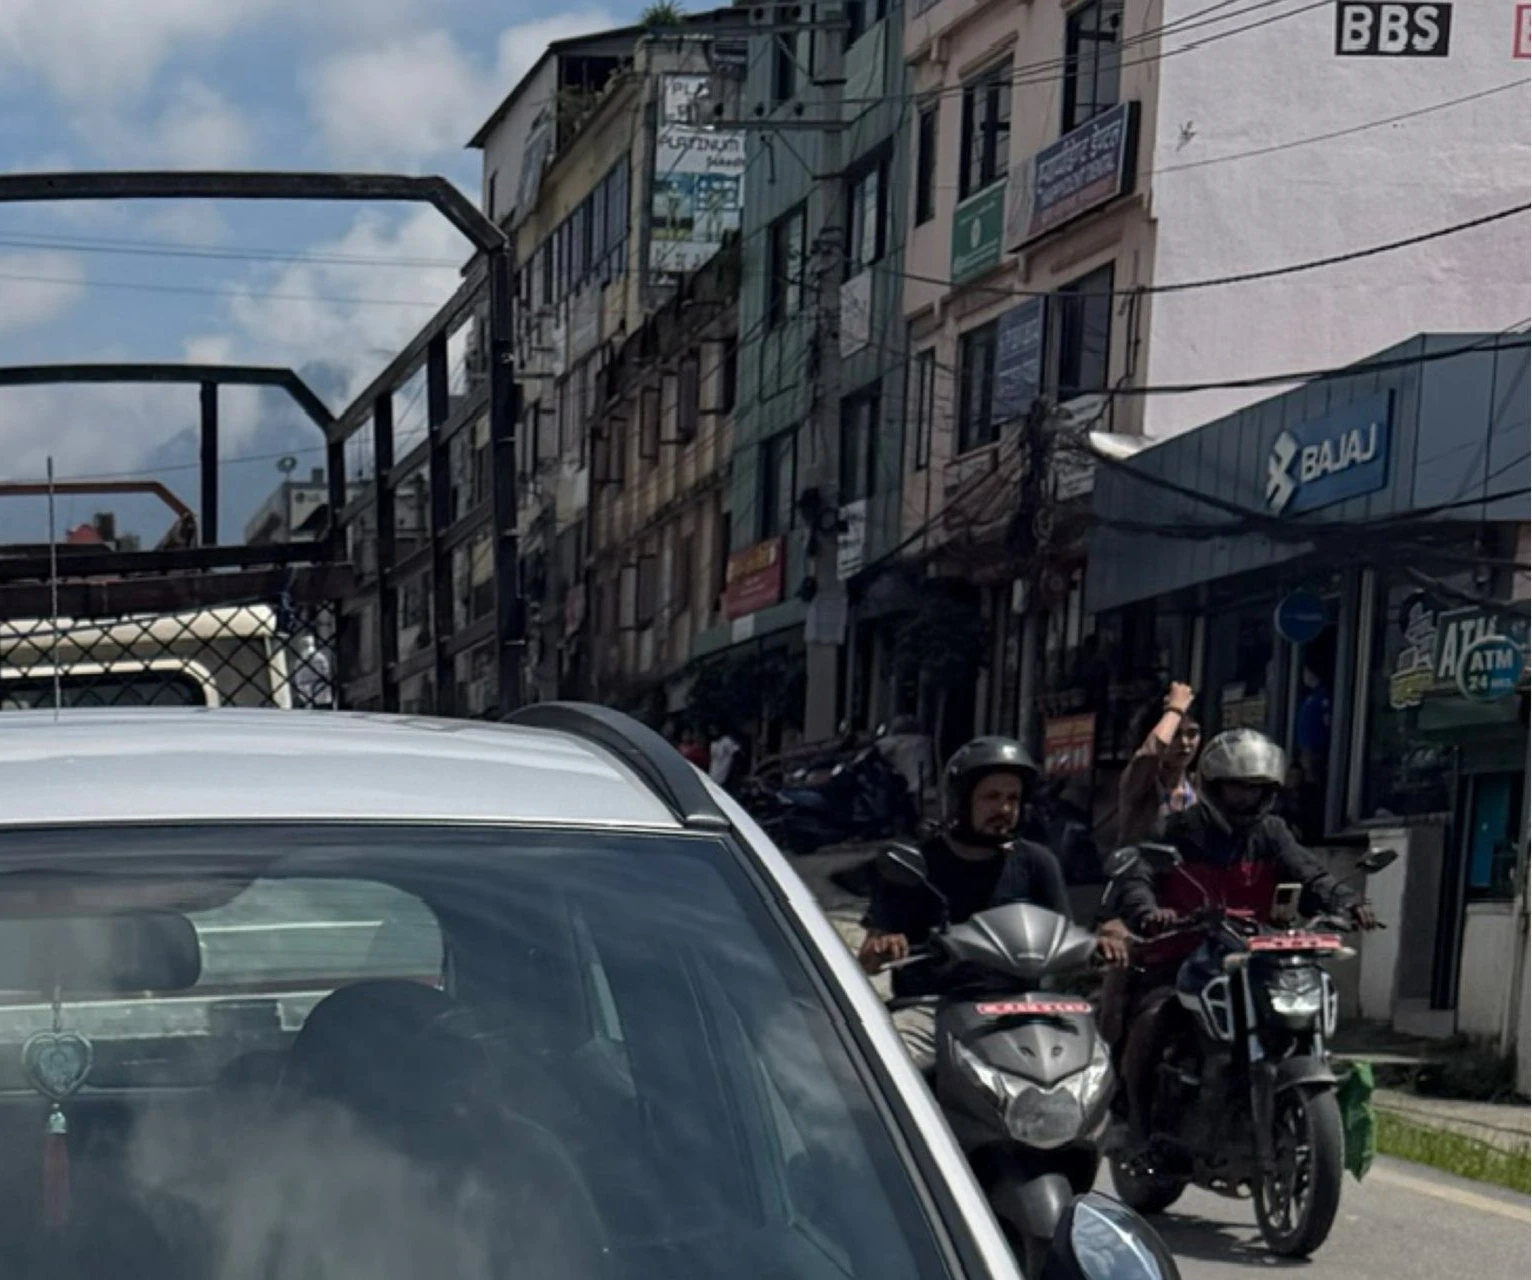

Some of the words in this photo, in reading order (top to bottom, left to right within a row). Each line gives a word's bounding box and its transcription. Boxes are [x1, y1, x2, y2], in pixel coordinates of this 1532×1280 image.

[1341, 4, 1440, 53] BBS
[1301, 421, 1377, 483] BAJAJ
[1471, 648, 1514, 673] ATM
[1468, 674, 1488, 692] 24
